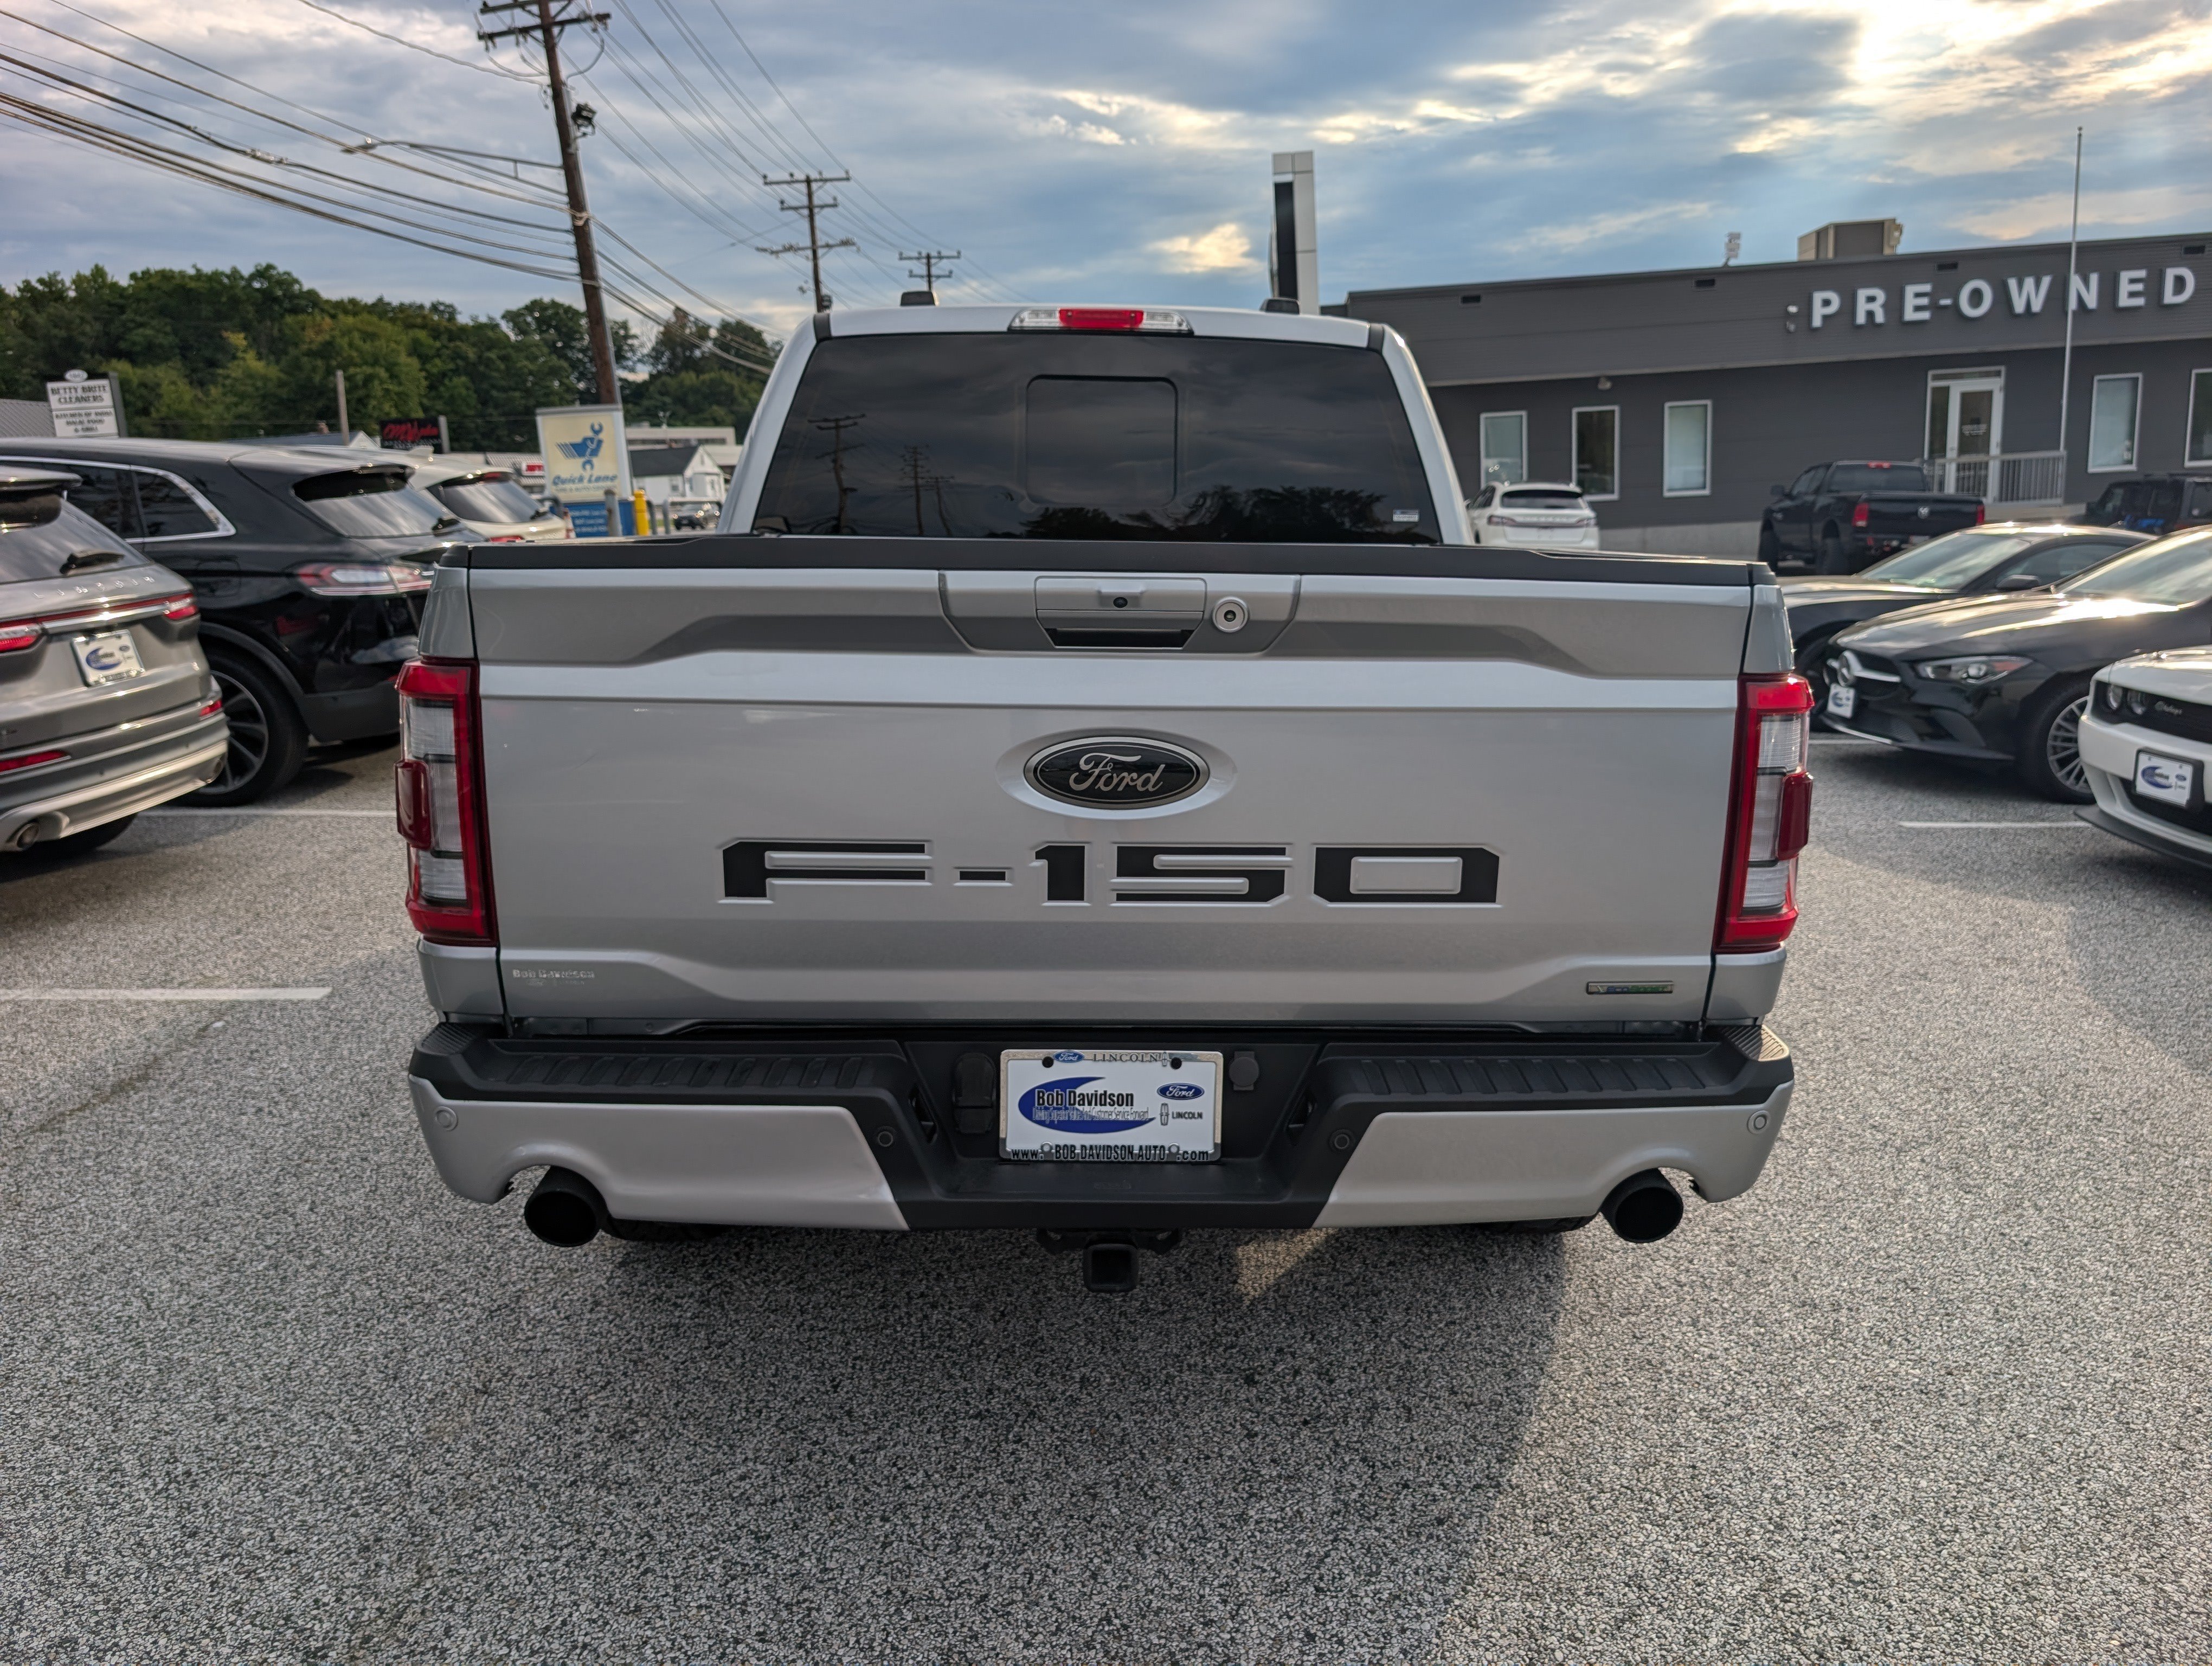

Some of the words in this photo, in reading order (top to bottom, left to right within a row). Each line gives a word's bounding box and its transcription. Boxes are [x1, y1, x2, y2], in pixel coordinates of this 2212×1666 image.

[1810, 267, 2196, 329] PRE-OWNED
[58, 395, 104, 403] CLEANERS
[553, 473, 584, 486] Quick
[588, 474, 618, 484] Lane
[1069, 752, 1166, 792] Ford
[723, 840, 1501, 904] F-150
[1058, 1052, 1079, 1061] Ford
[1093, 1053, 1159, 1062] LINCOLN
[1037, 1090, 1064, 1107] Bob
[1068, 1090, 1134, 1107] Davidson
[1166, 1085, 1195, 1098] Ford
[1172, 1111, 1203, 1120] LINCOLN
[1012, 1149, 1044, 1160] www.
[1054, 1144, 1077, 1160] BOB
[1080, 1144, 1134, 1161] DAVIDSON
[1139, 1144, 1166, 1161] AUTO
[1176, 1150, 1209, 1161] .com
